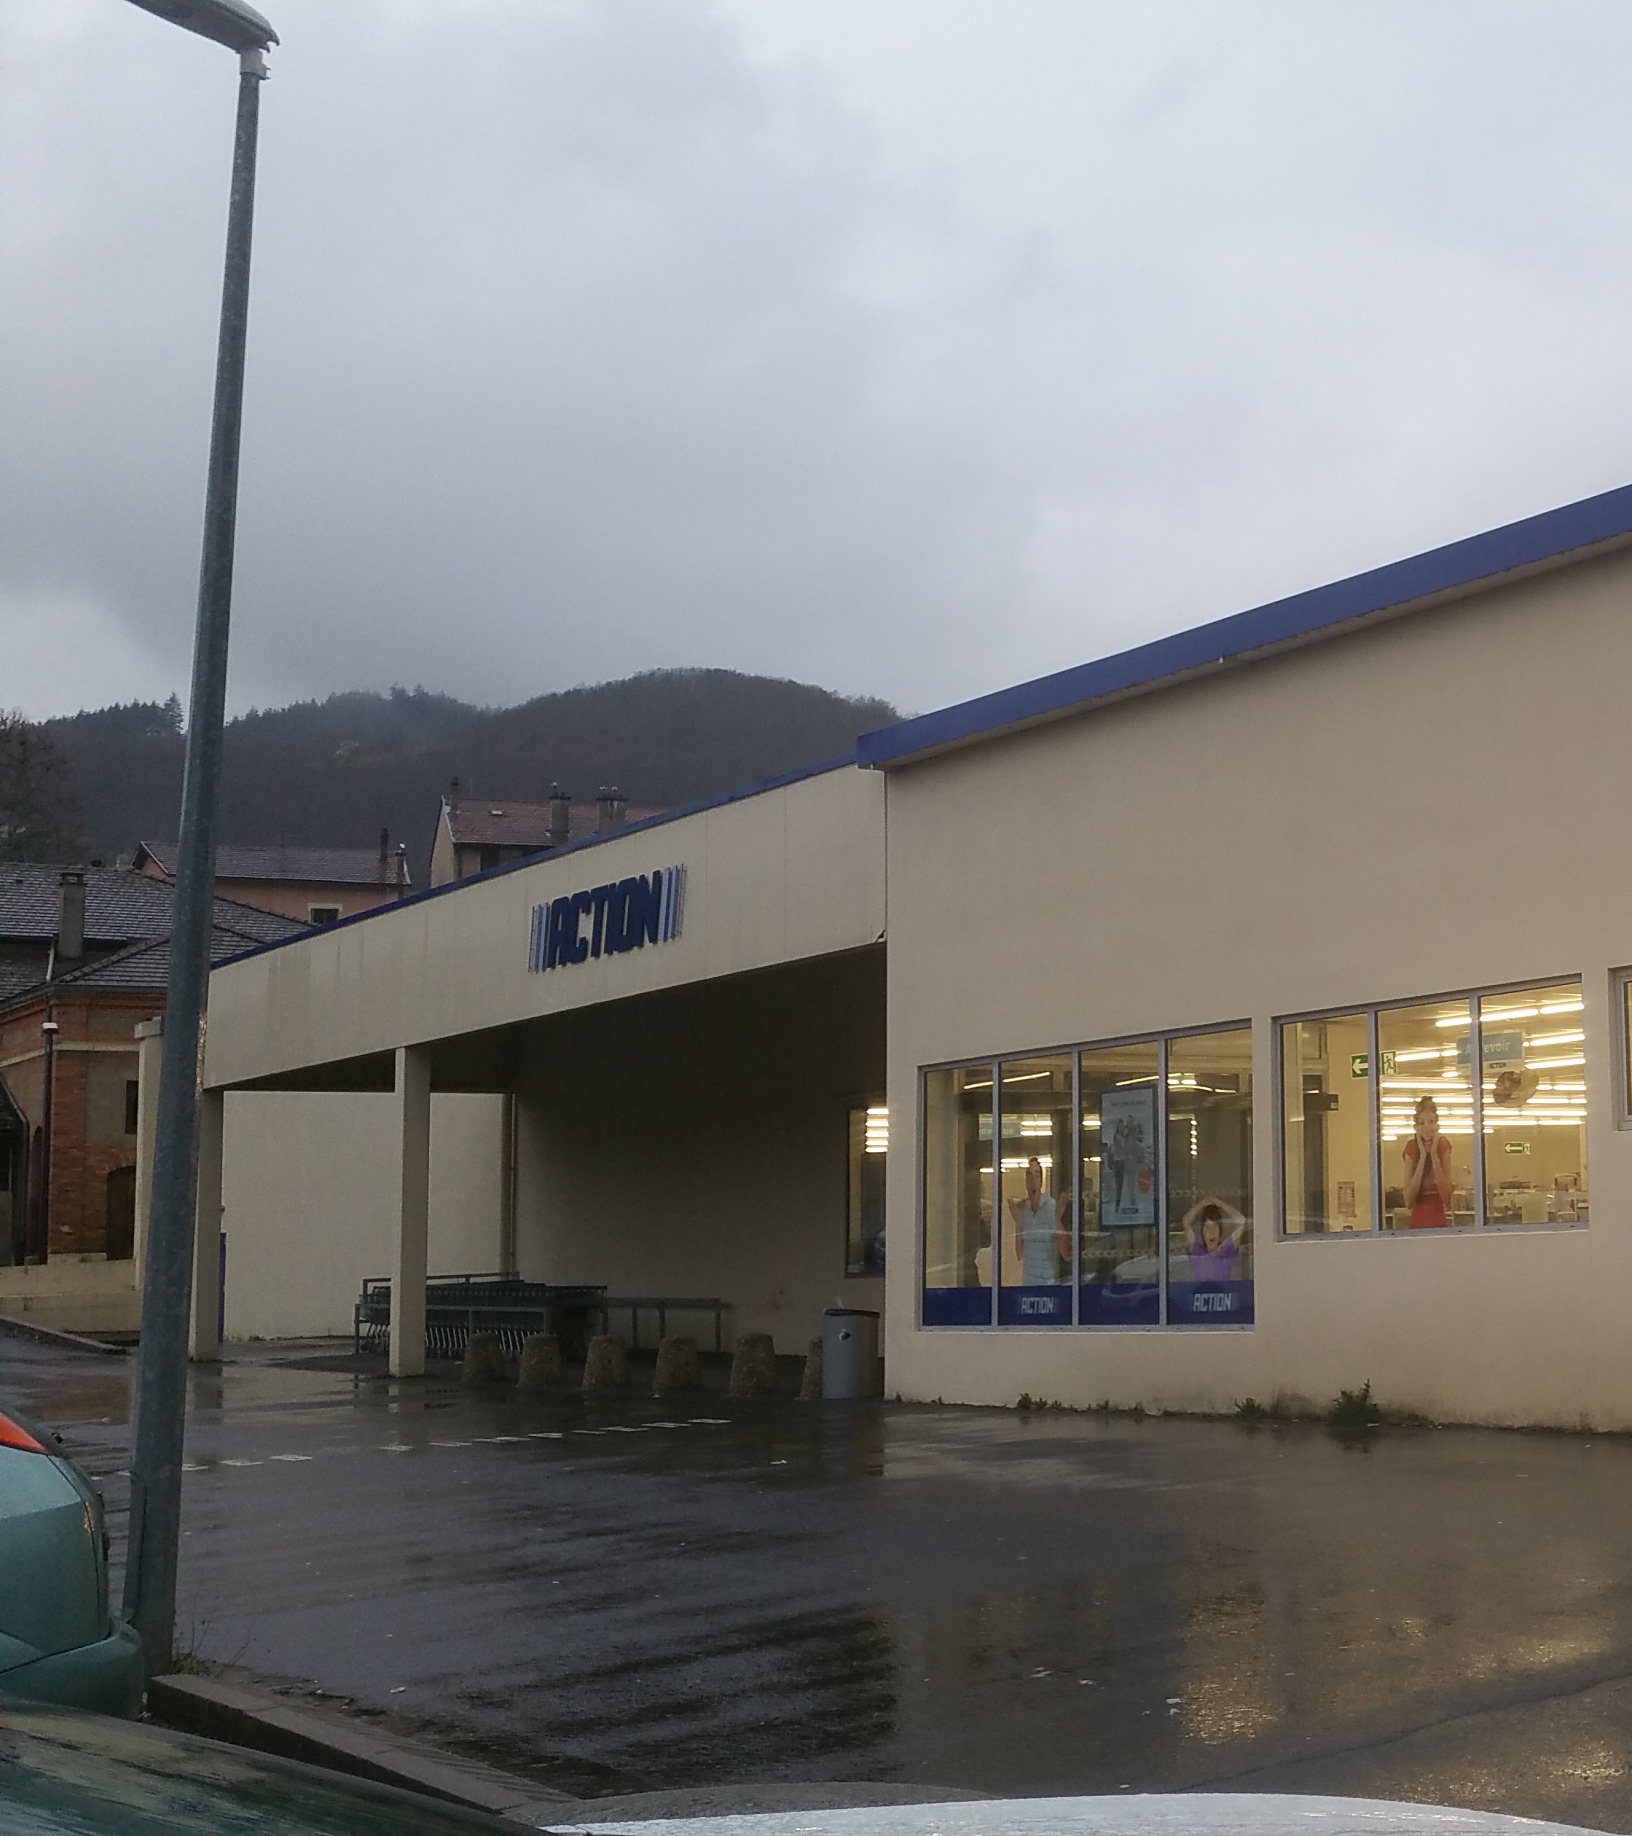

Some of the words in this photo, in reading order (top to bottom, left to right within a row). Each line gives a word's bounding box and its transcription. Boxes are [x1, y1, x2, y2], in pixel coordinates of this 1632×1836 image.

[547, 869, 663, 969] ACTION
[1021, 1297, 1054, 1314] ACTION
[1193, 1293, 1231, 1312] ACTION
